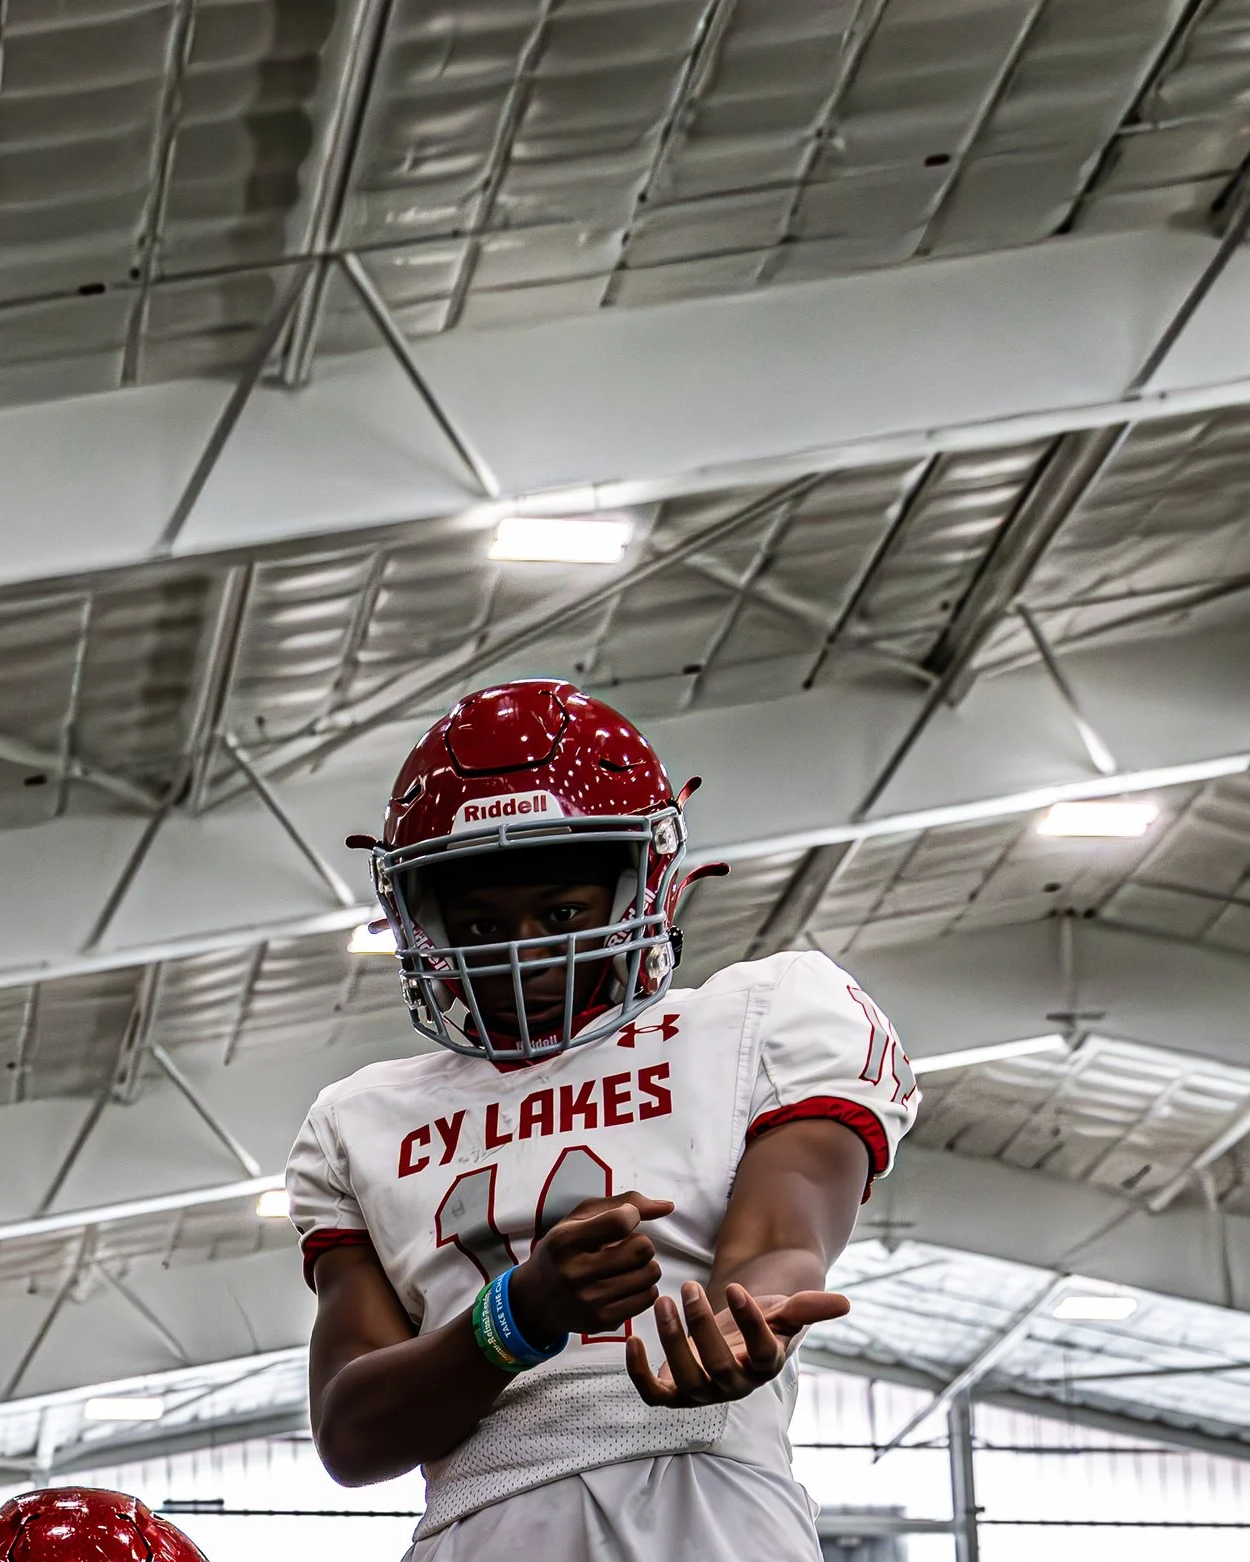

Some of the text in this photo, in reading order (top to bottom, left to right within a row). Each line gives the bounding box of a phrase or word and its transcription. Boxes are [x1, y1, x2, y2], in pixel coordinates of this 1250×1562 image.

[463, 794, 548, 823] Riddell
[397, 1061, 674, 1179] CY LAKES
[495, 1293, 503, 1313] THE
[497, 1312, 511, 1338] TAKE
